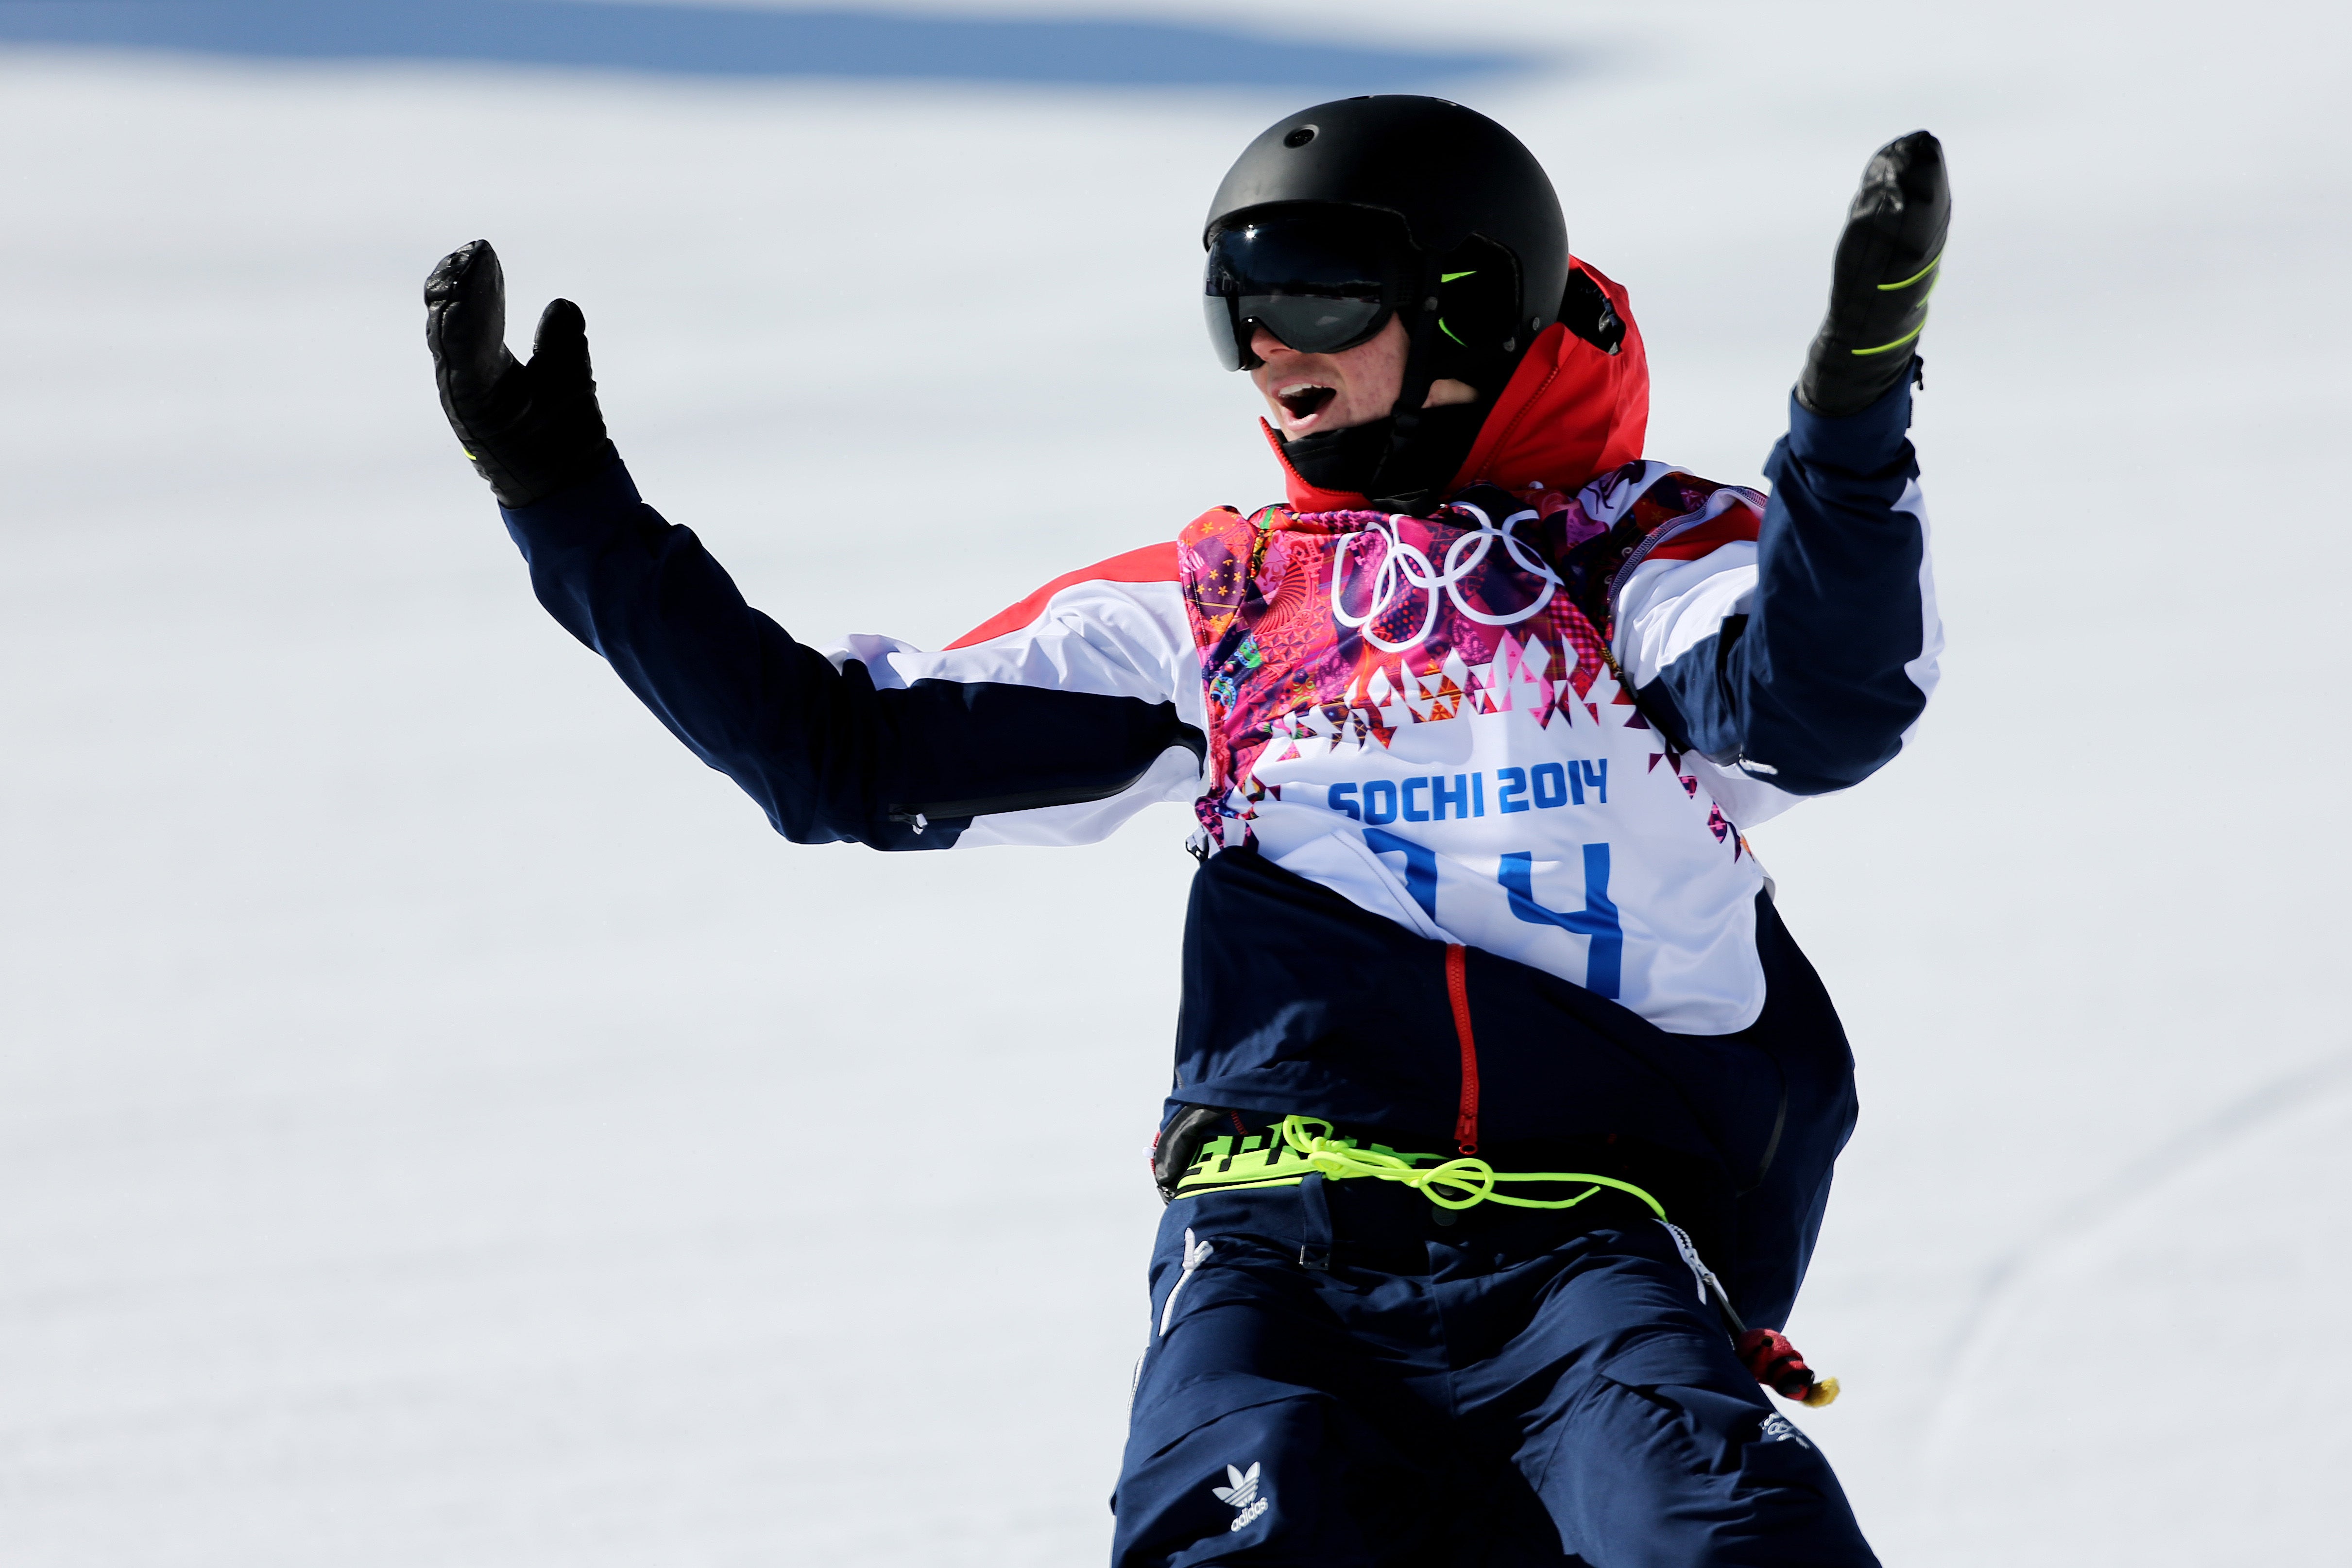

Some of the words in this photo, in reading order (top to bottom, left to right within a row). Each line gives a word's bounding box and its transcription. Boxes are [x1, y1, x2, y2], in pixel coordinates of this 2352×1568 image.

[1328, 772, 1485, 826] SOCHI
[1498, 758, 1607, 814] 2014
[1231, 1497, 1269, 1533] adidas
